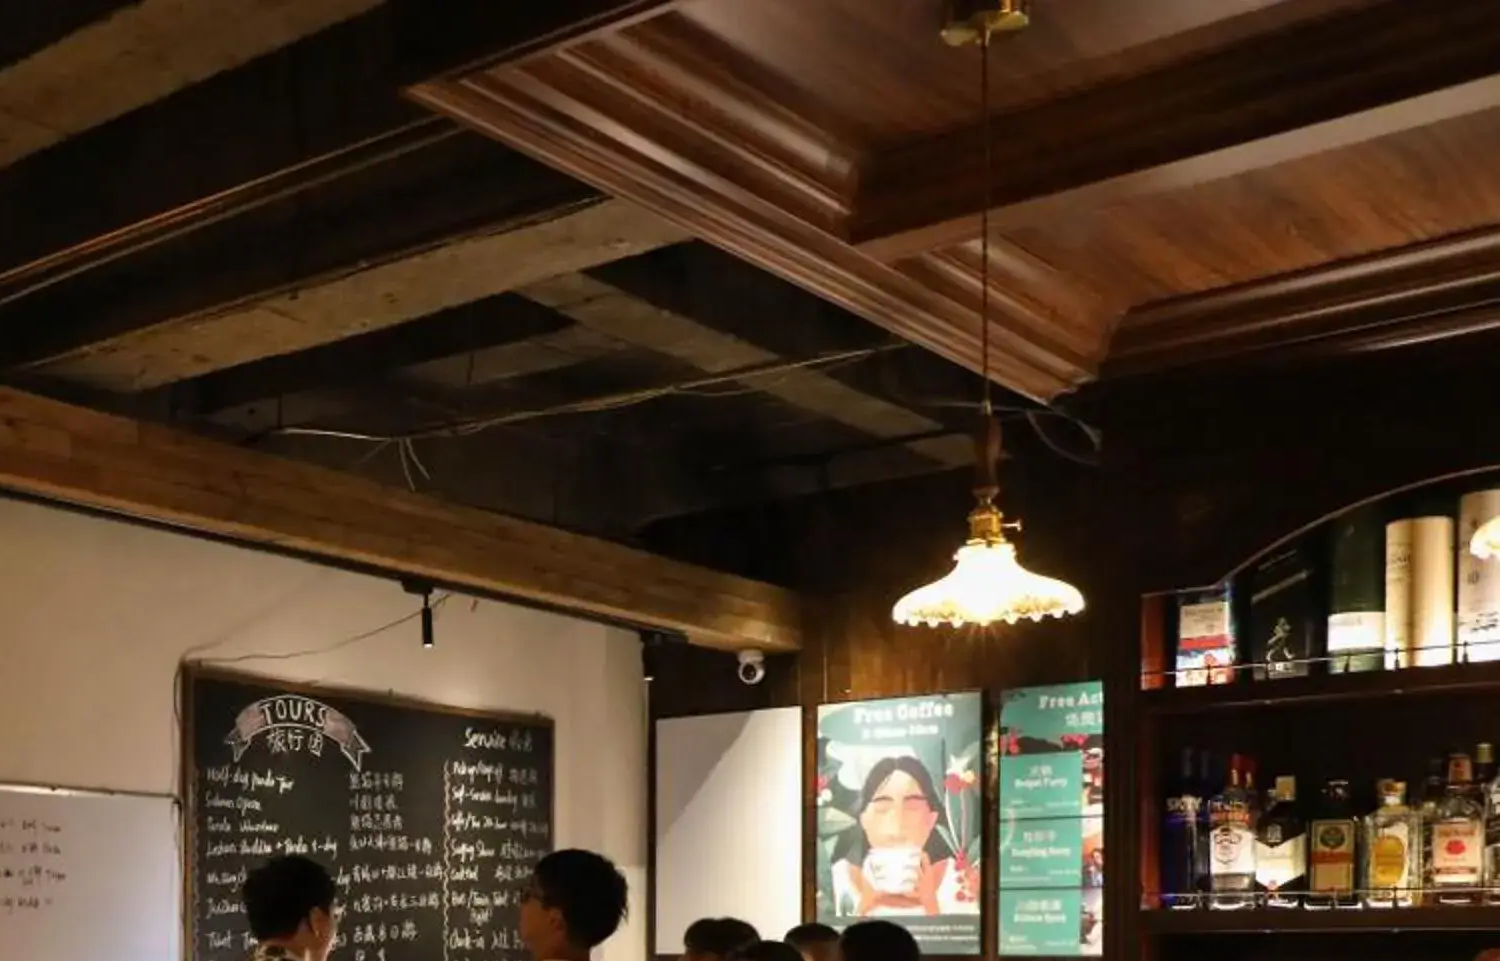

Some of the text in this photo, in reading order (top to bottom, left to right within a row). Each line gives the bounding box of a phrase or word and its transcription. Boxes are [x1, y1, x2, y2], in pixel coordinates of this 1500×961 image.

[260, 699, 326, 727] TOURS
[853, 701, 954, 724] Free Coffee
[1039, 696, 1075, 710] Free
[267, 729, 324, 757] 旅行团
